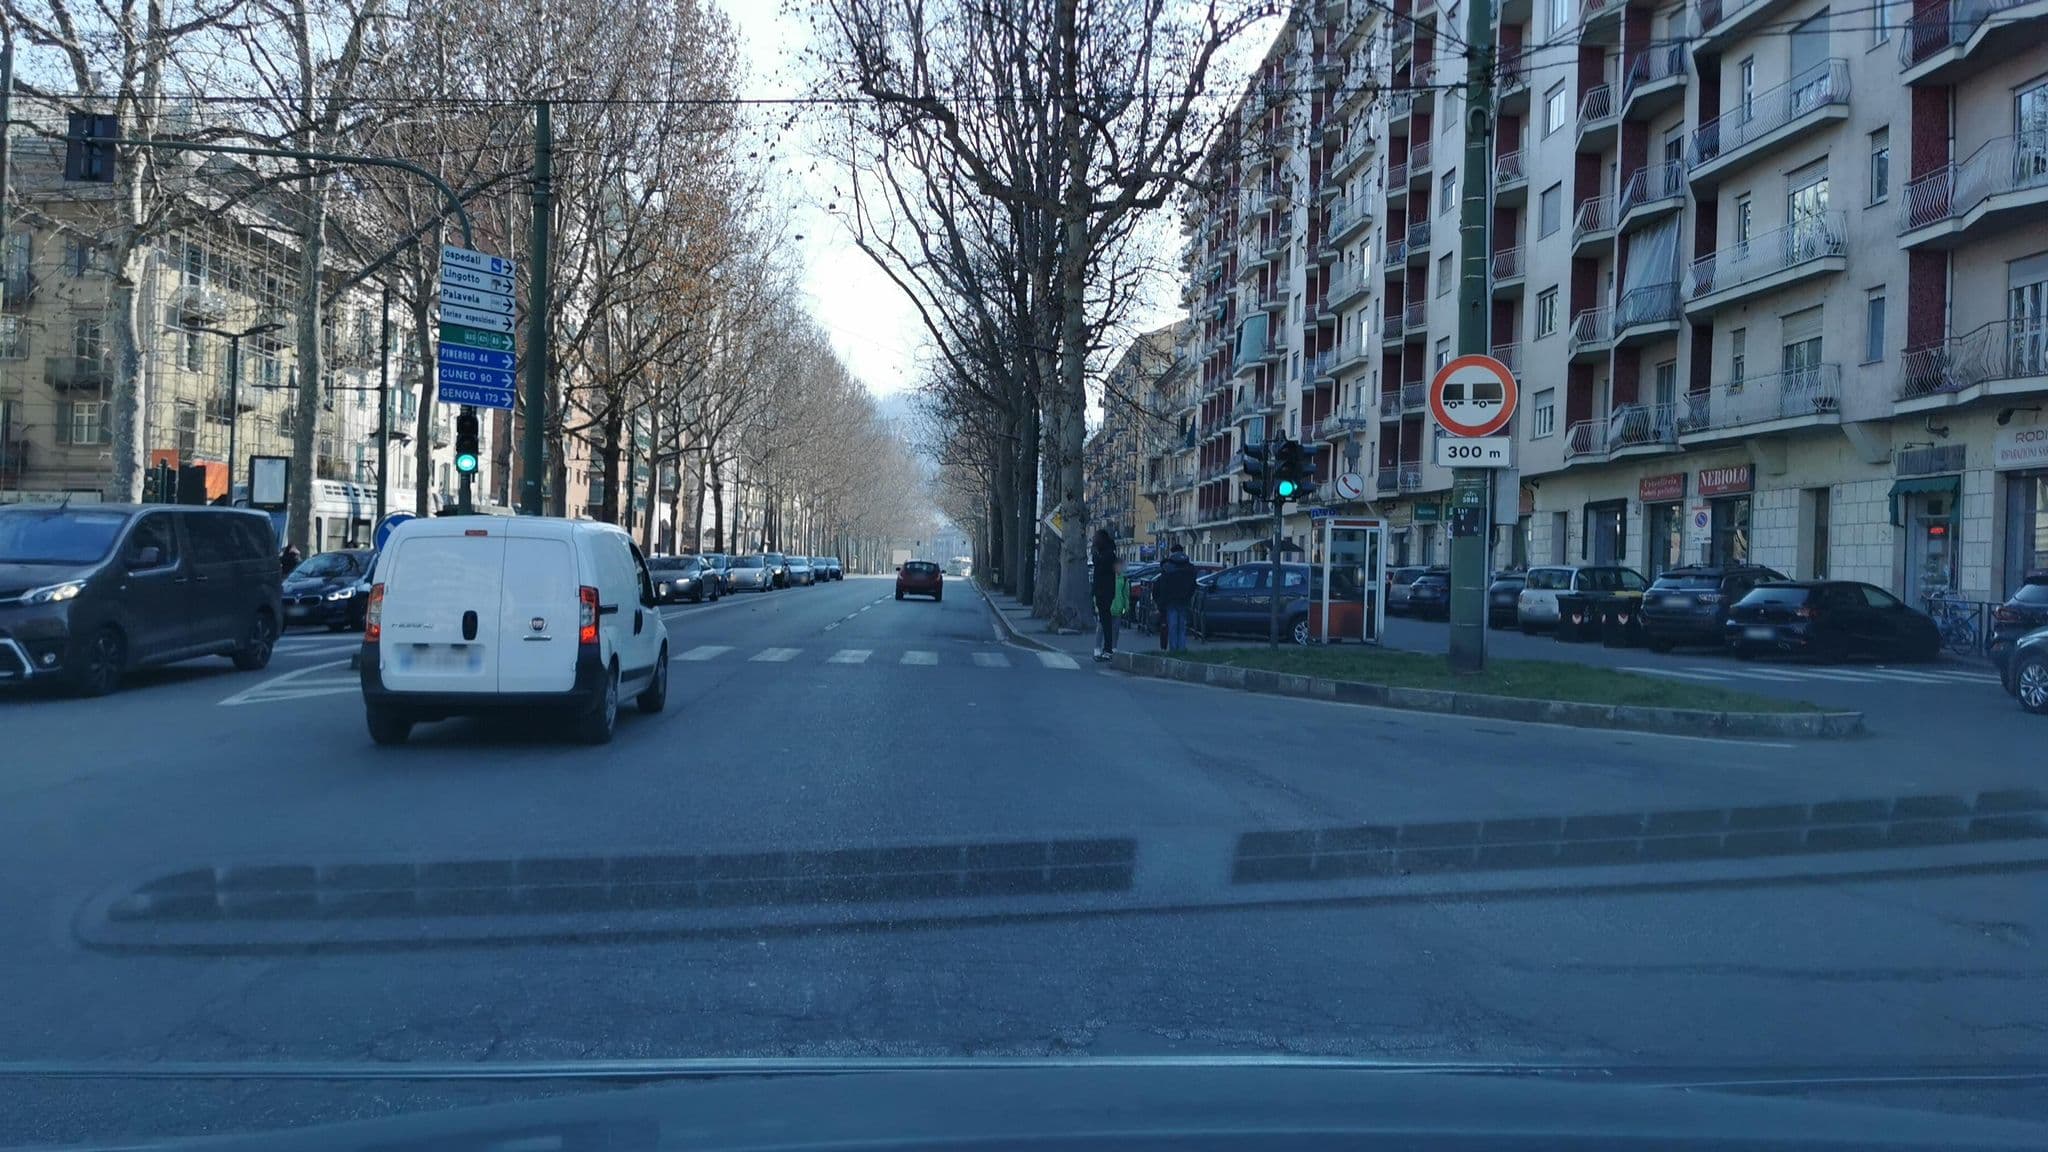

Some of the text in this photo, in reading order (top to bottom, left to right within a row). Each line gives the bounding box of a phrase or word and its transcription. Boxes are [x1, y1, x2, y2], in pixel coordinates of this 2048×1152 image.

[445, 250, 480, 265] ospedali
[444, 268, 480, 284] Lingotto
[443, 288, 480, 304] Palavela
[441, 347, 488, 363] PINEROLO 44
[441, 368, 492, 383] CUNEO 90
[441, 387, 499, 403] GENOVA 173
[1447, 445, 1501, 459] 300 m
[1700, 466, 1747, 487] NEBIOLO
